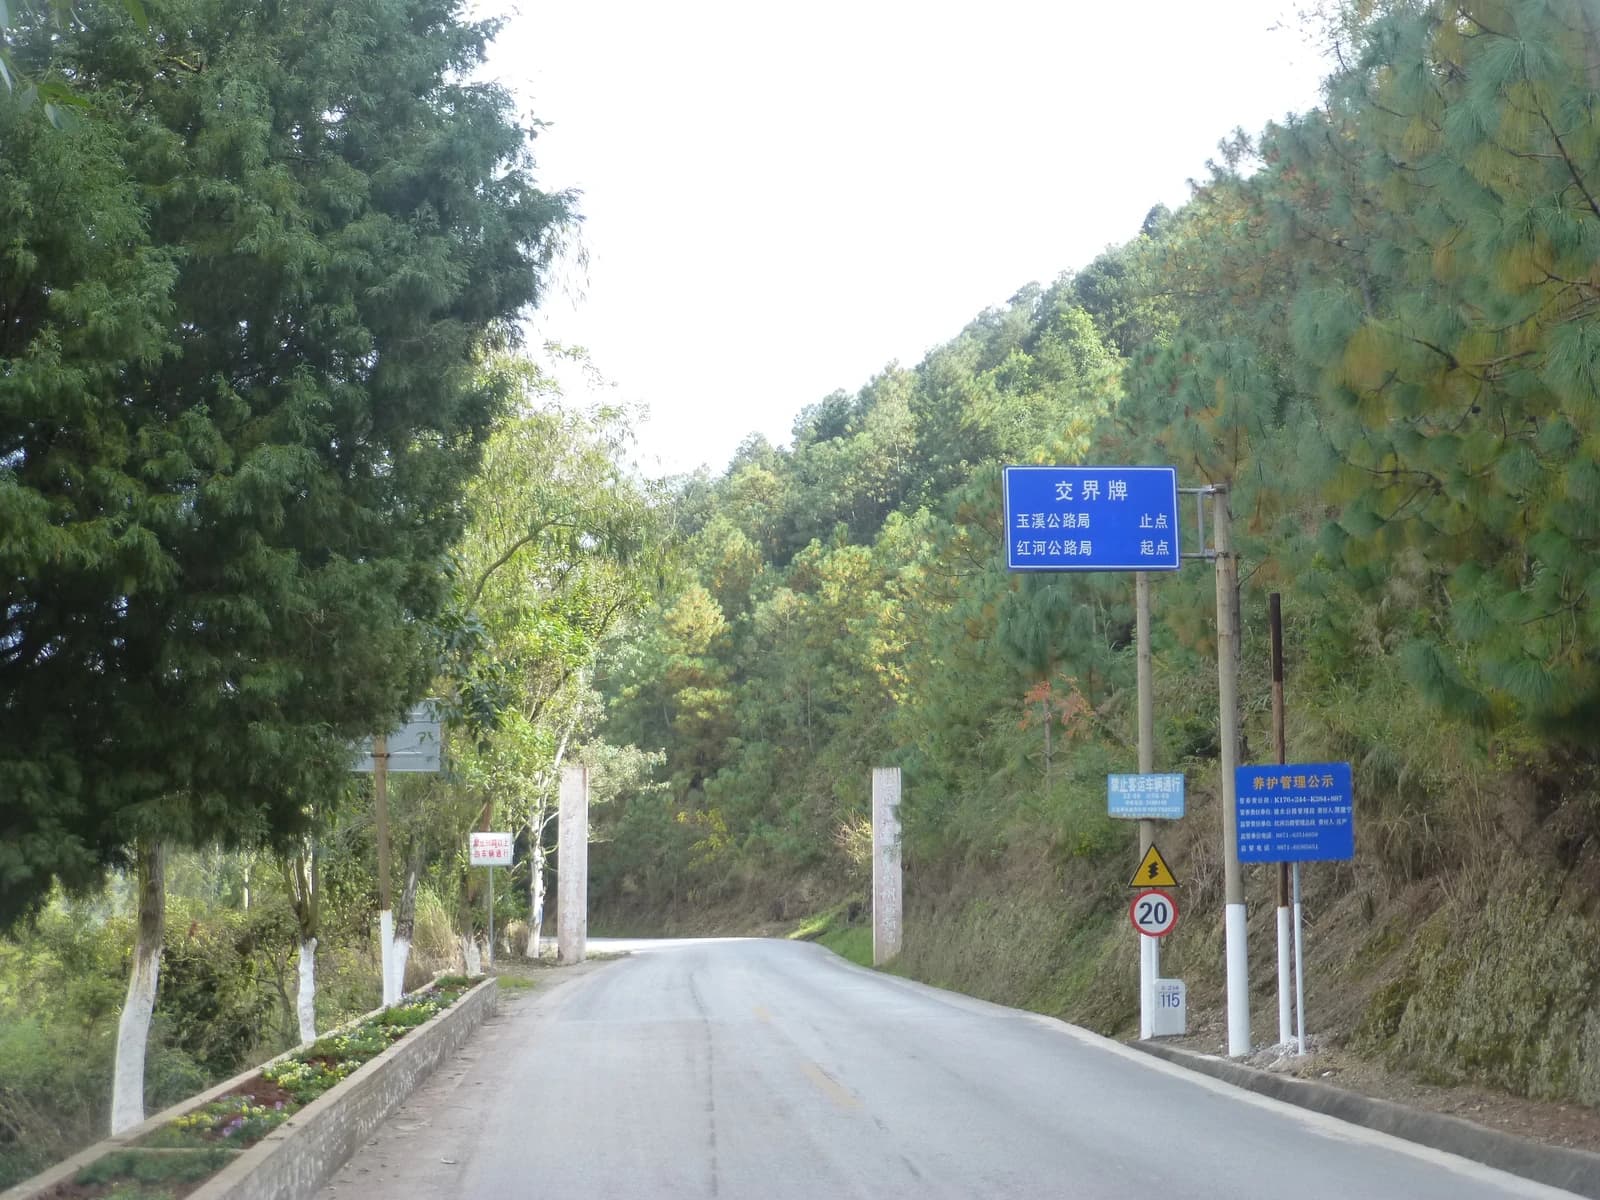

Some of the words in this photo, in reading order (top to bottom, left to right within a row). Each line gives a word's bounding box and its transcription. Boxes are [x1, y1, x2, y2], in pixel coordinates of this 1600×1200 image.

[1055, 479, 1128, 501] 交界牌
[1016, 512, 1091, 529] 玉溪公路局
[1139, 512, 1169, 529] 止点
[1016, 540, 1092, 556] 红河公路局
[1140, 539, 1170, 556] 起点
[1253, 774, 1334, 790] 养护管理公示
[1139, 902, 1168, 925] 20
[1160, 992, 1180, 1008] 115
